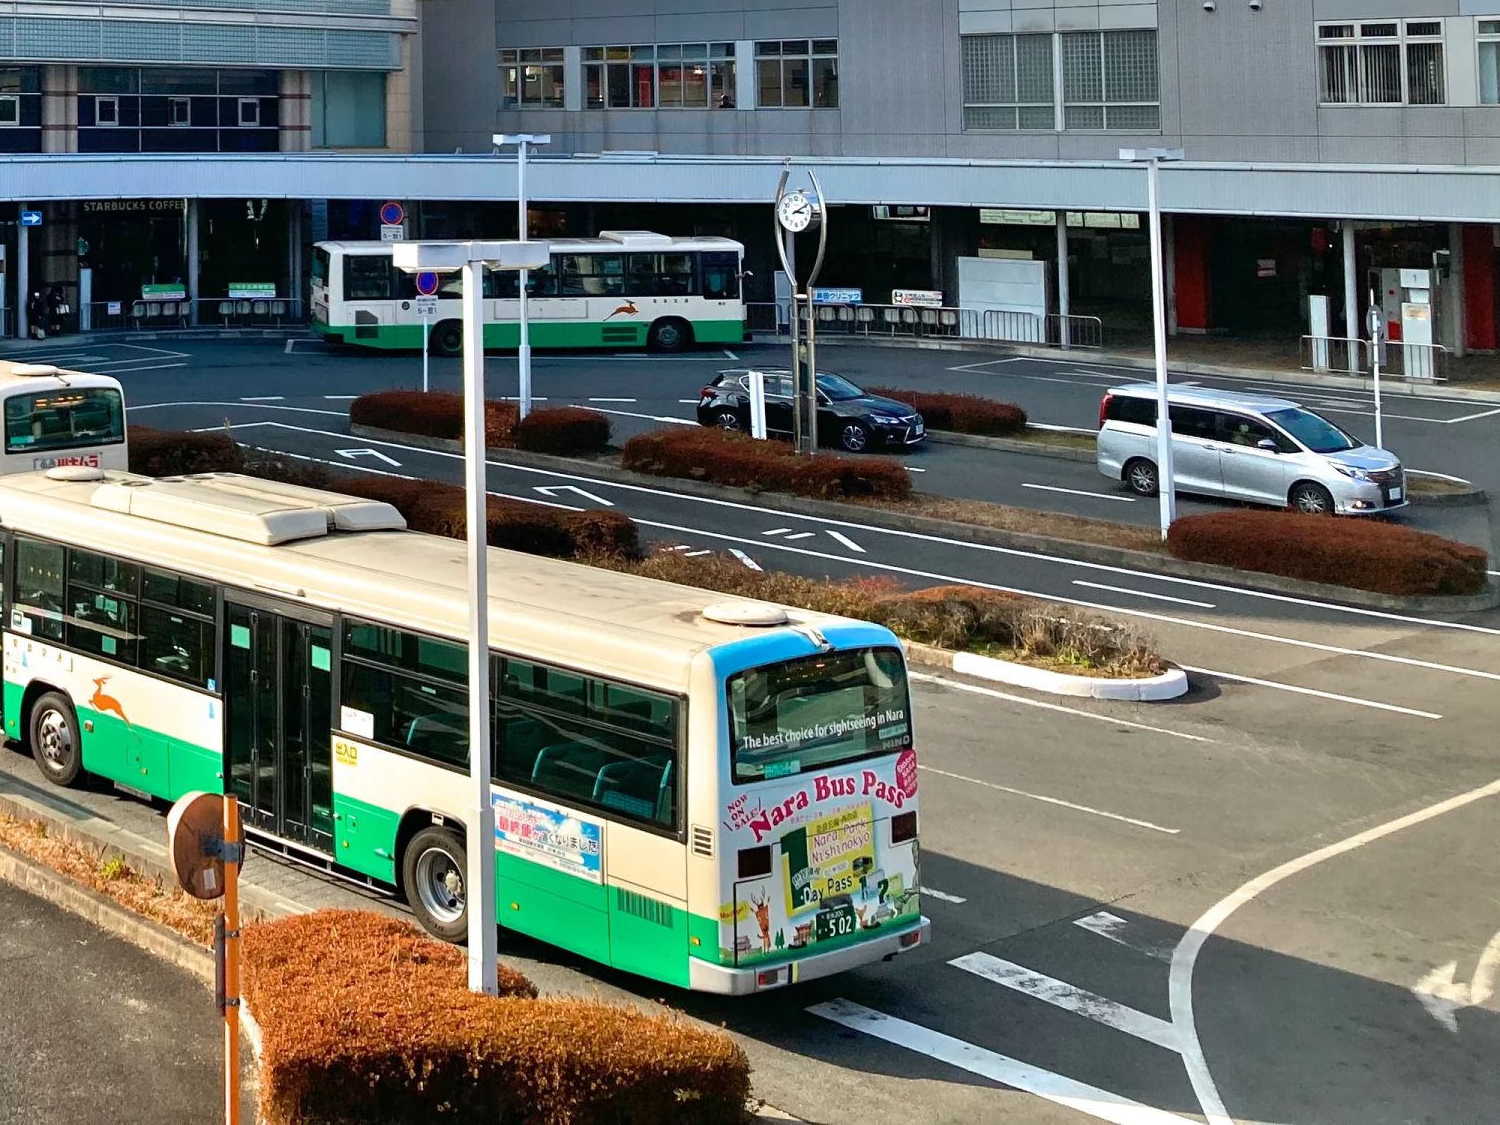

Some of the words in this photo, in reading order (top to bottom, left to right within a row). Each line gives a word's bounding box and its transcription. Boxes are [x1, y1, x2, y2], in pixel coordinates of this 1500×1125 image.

[83, 201, 146, 212] STARBUCKS
[149, 200, 185, 211] COFFEE
[743, 735, 762, 750] The
[763, 730, 784, 747] best
[785, 725, 814, 743] choice
[815, 722, 830, 737] for
[829, 714, 877, 736] sightseeing
[877, 713, 885, 725] in
[886, 709, 905, 724] Nara
[336, 742, 357, 759] 出入口
[727, 794, 749, 813] NOW
[749, 788, 810, 843] Nara
[814, 775, 856, 802] Bus
[861, 771, 906, 809] Pass
[730, 806, 746, 822] ON
[814, 831, 838, 848] Nara
[843, 818, 868, 836] Park
[812, 832, 870, 864] Nishinokyo
[827, 876, 853, 895] Pass
